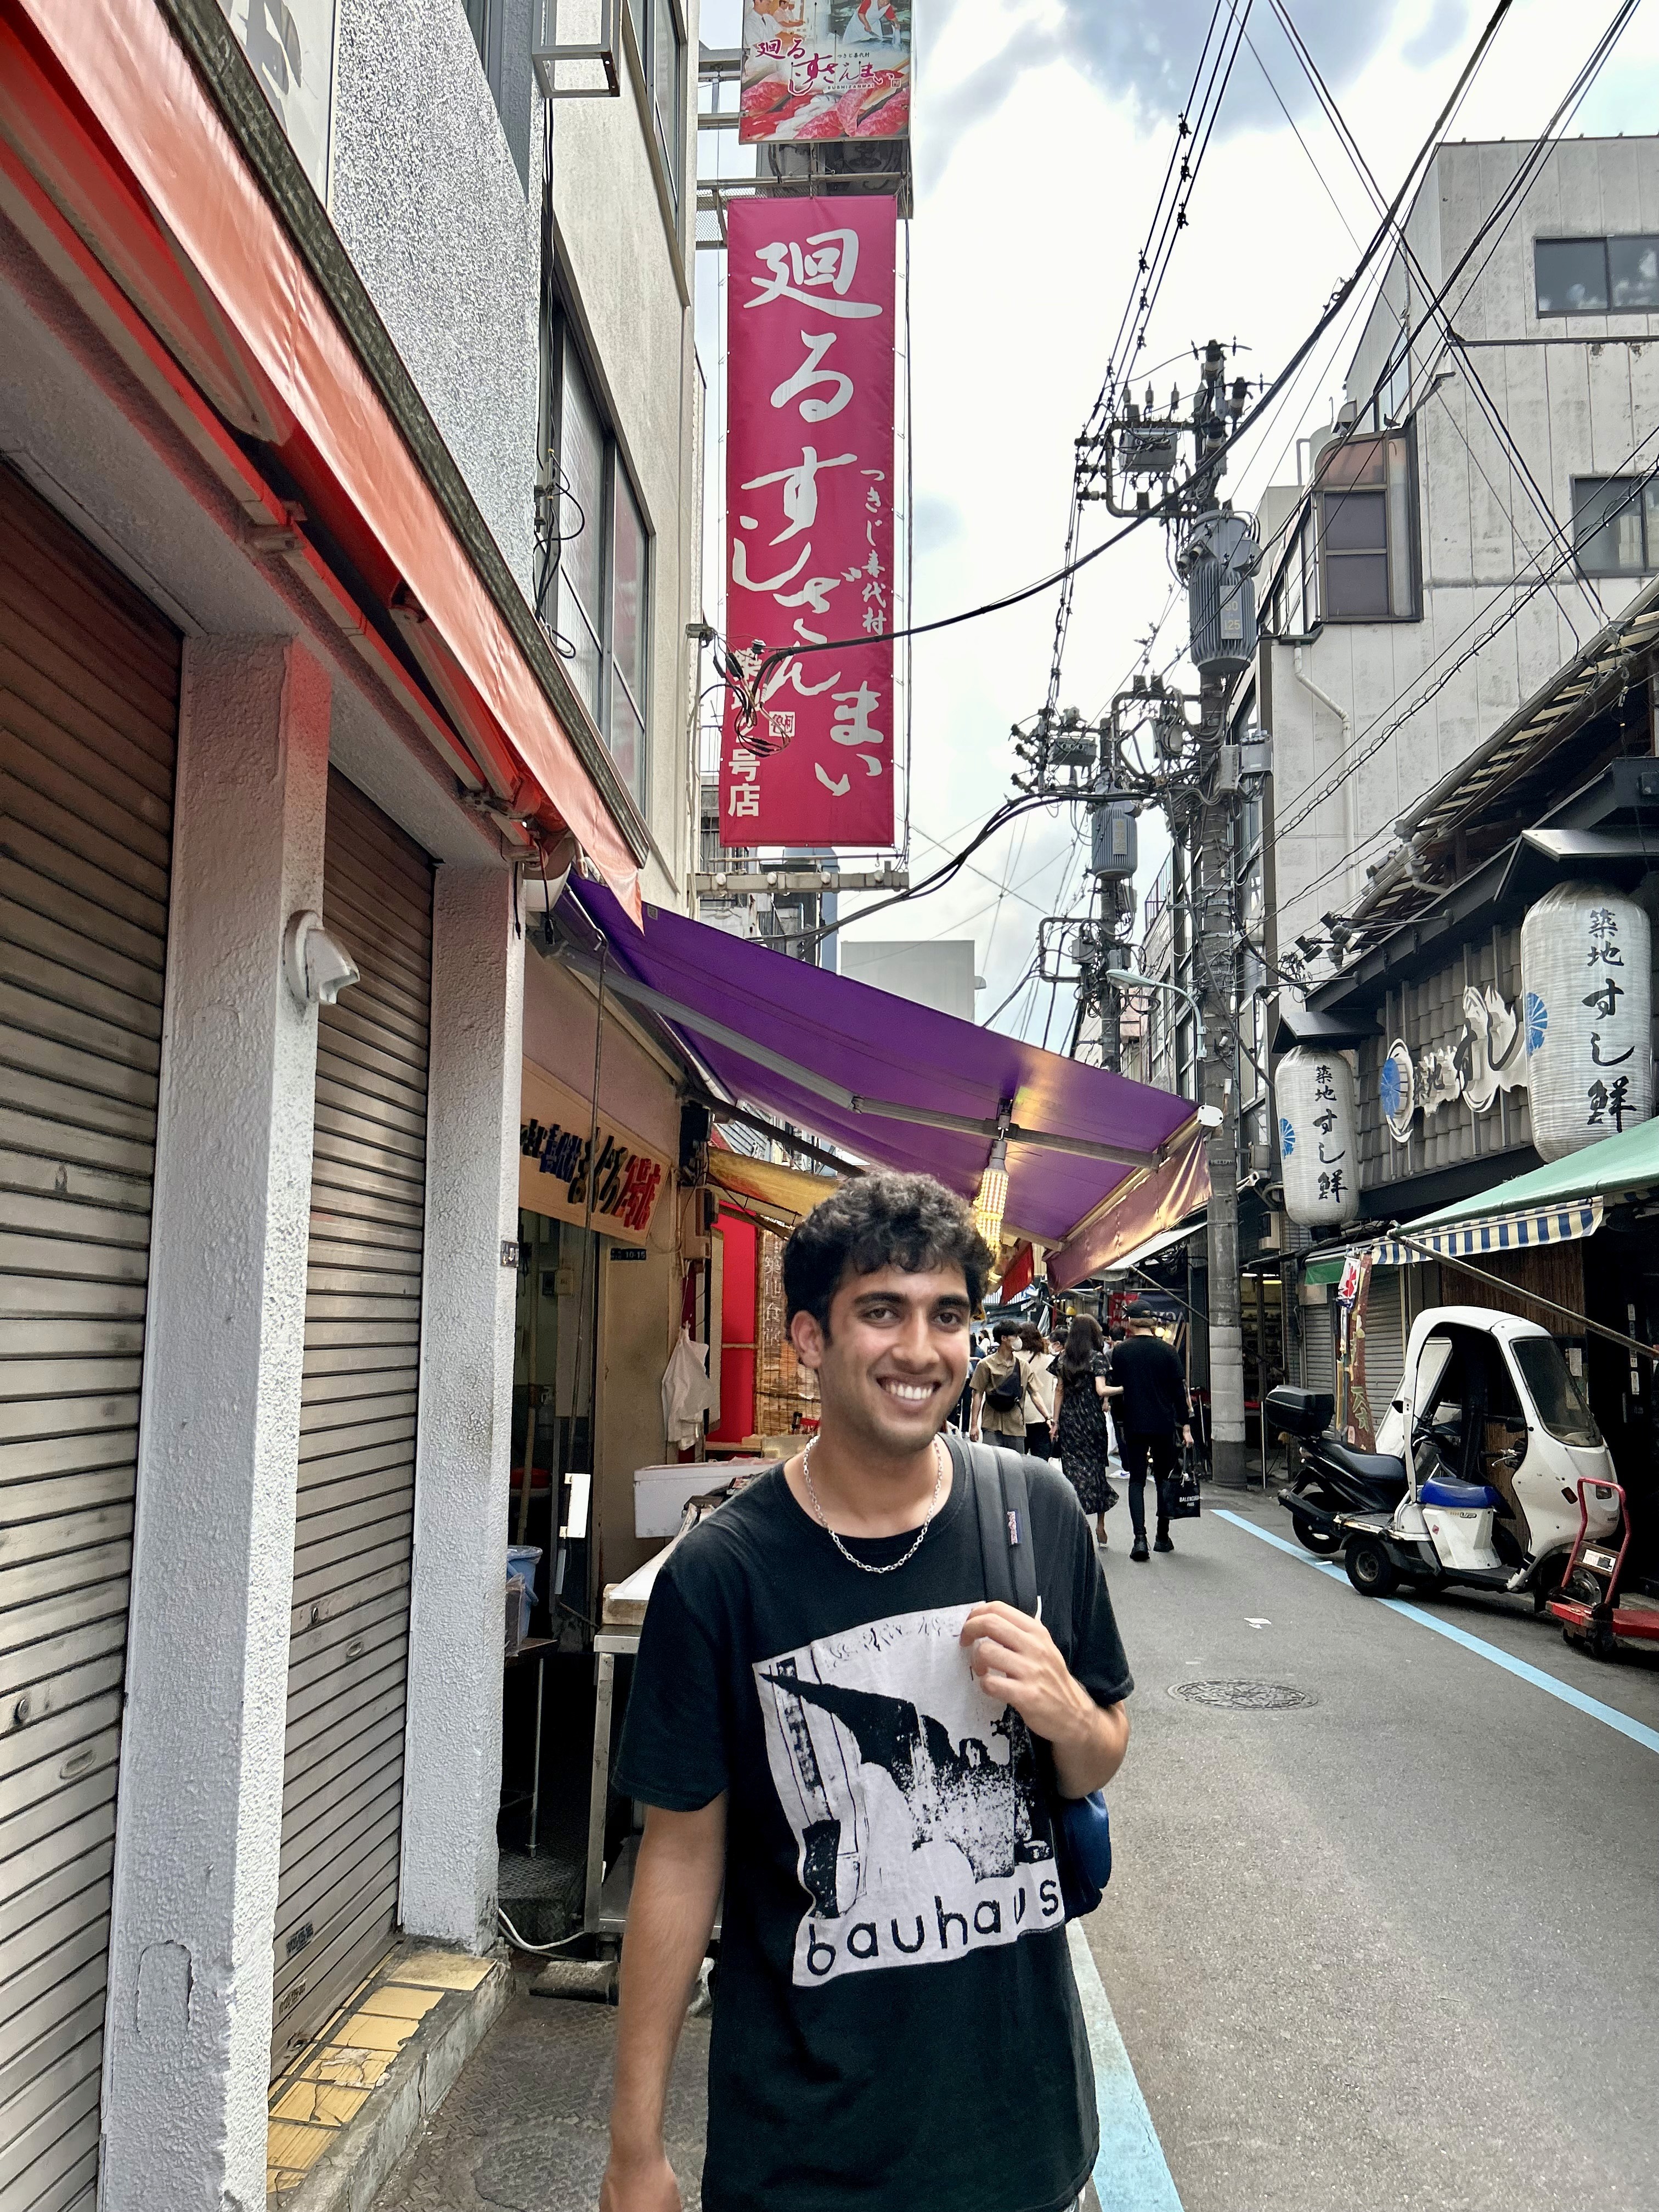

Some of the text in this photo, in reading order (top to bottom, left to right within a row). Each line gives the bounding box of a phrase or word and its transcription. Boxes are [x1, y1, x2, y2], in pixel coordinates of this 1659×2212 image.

[1223, 619, 1240, 631] 125
[1581, 908, 1638, 1133] 築地すし鮮
[1312, 1065, 1349, 1203] 築地すし鮮
